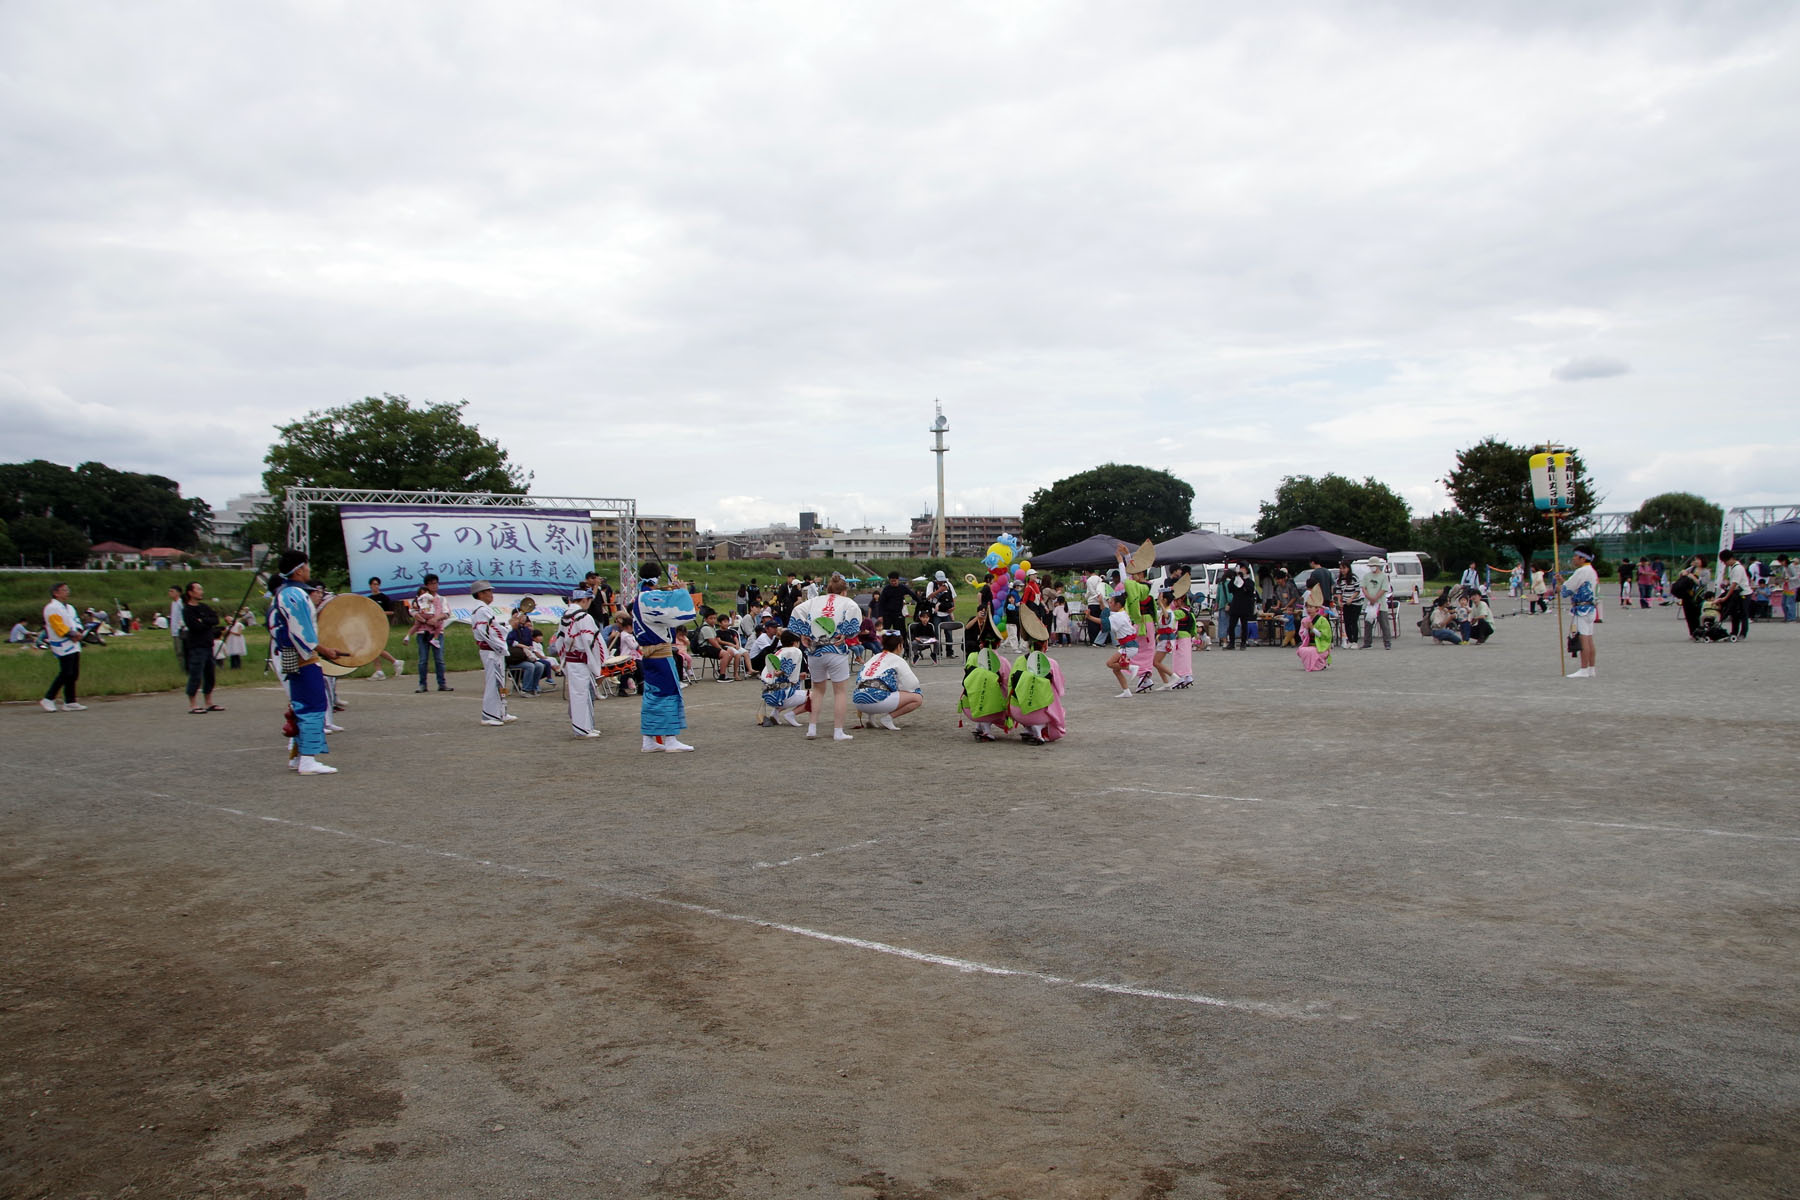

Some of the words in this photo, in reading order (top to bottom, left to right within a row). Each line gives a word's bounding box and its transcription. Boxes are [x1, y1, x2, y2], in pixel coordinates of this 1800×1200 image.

[358, 521, 588, 559] 丸子の渡し祭り
[391, 558, 578, 581] 丸子の渡し実行委員会
